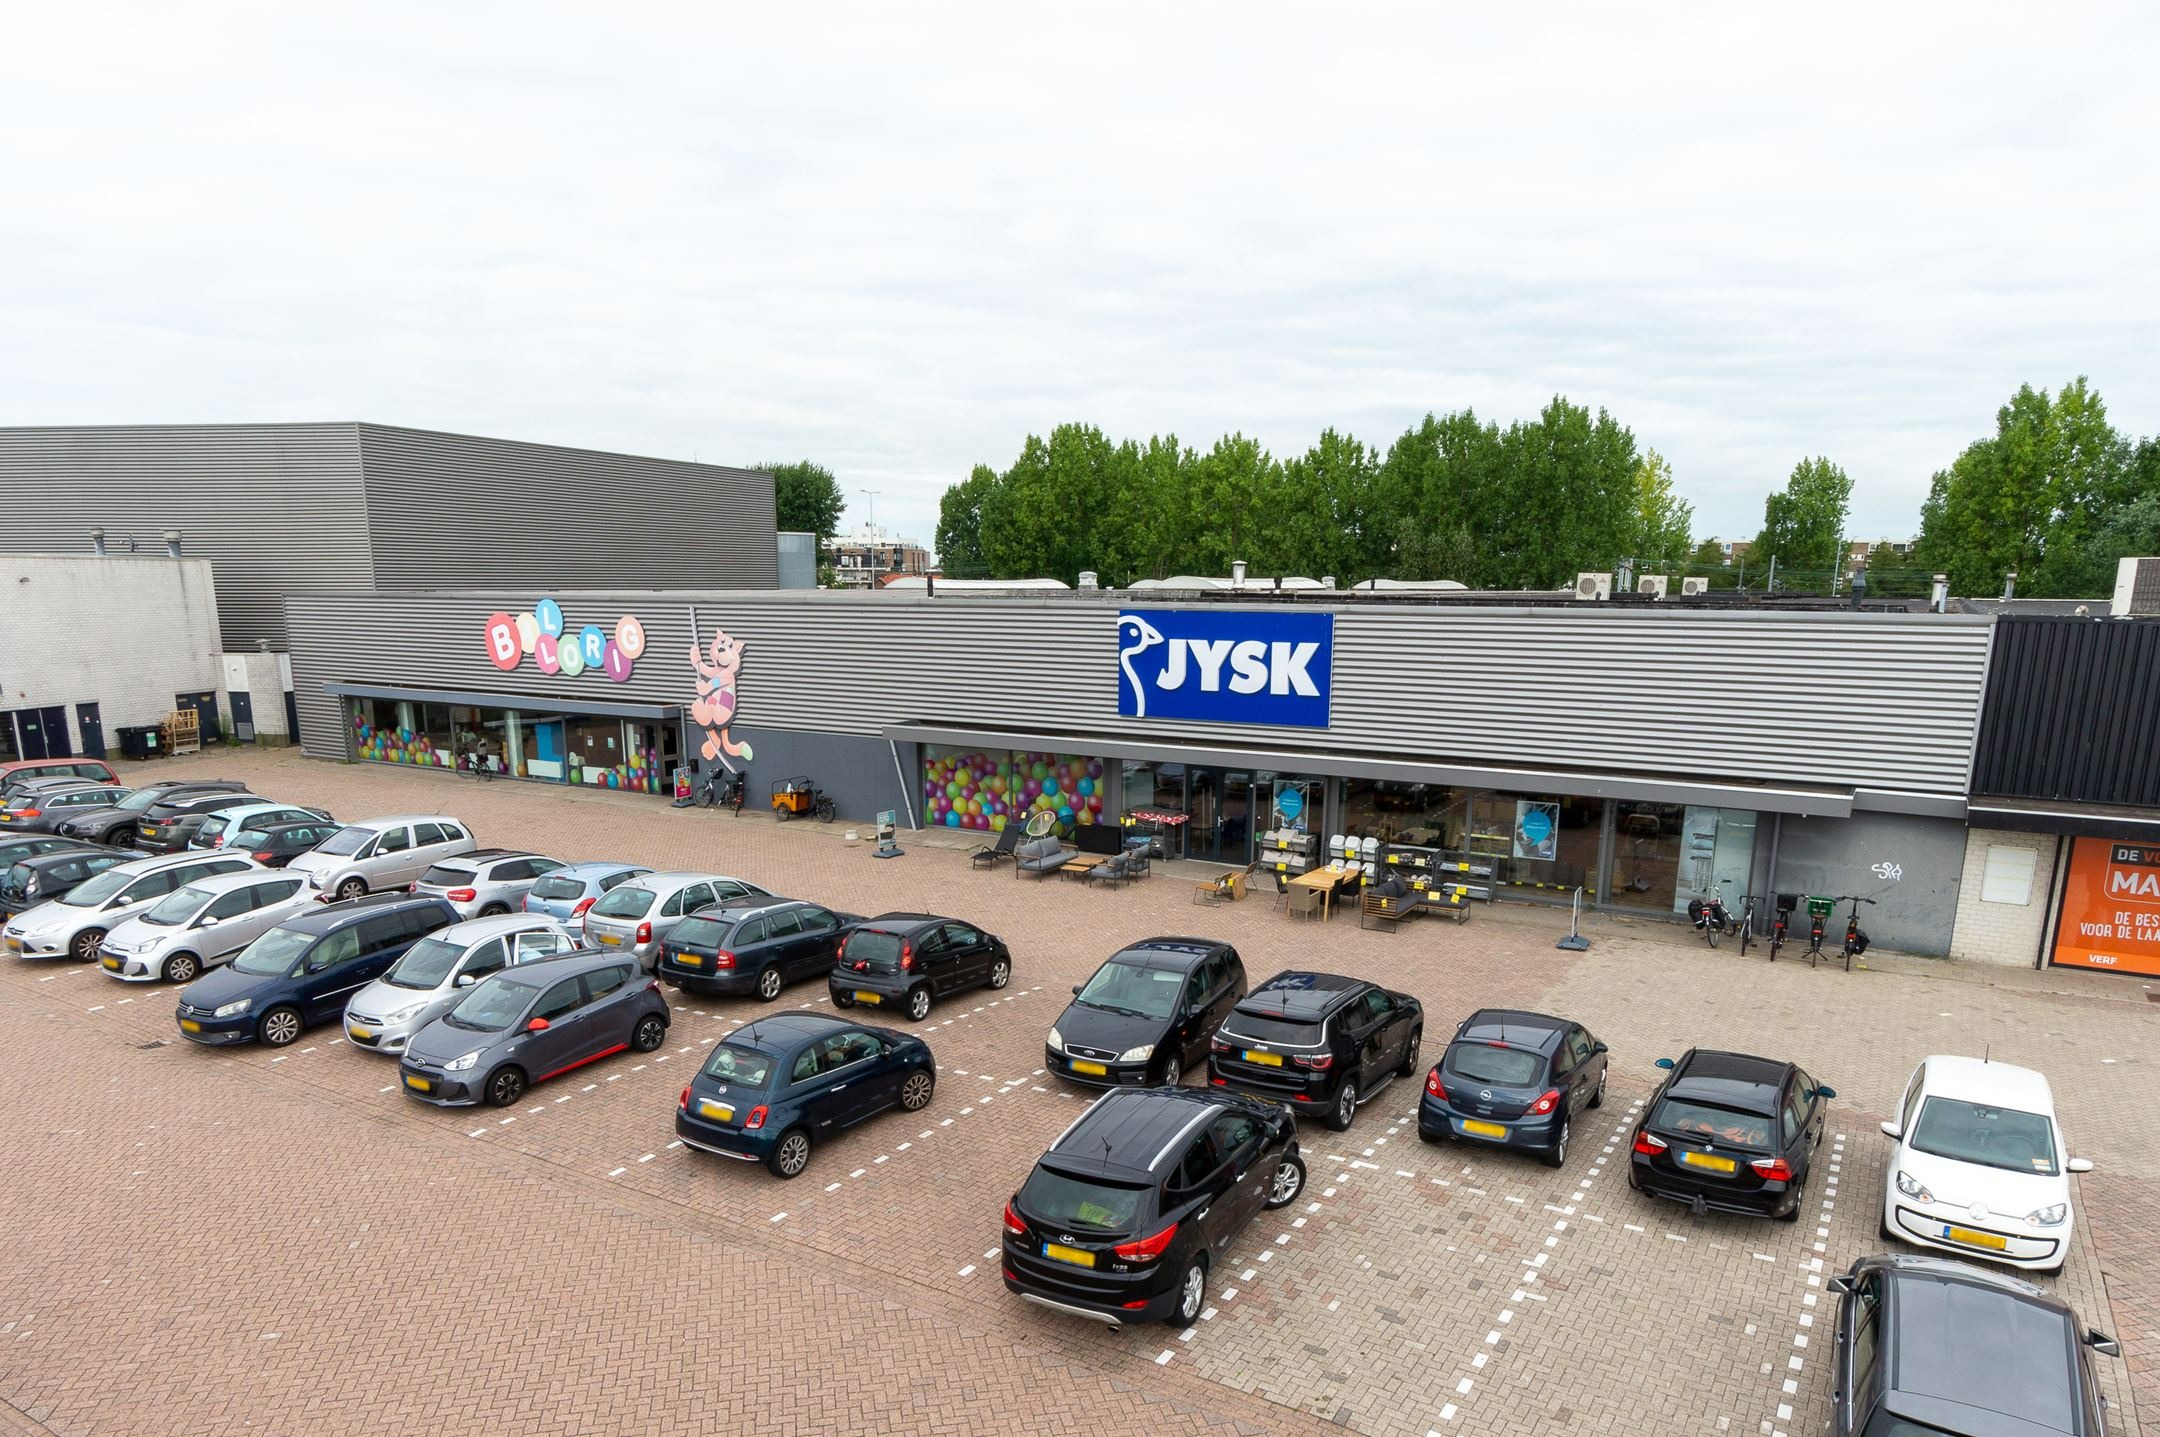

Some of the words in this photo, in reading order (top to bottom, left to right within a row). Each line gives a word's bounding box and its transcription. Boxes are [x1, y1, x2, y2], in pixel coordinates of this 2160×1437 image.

[1156, 638, 1320, 697] JYSK
[2117, 848, 2139, 861] DE
[2111, 870, 2160, 897] MA
[2115, 911, 2132, 925] DE
[2135, 913, 2160, 927] BES
[2080, 922, 2113, 938] VOOR
[2117, 925, 2133, 939] DE
[2088, 954, 2118, 965] VERF
